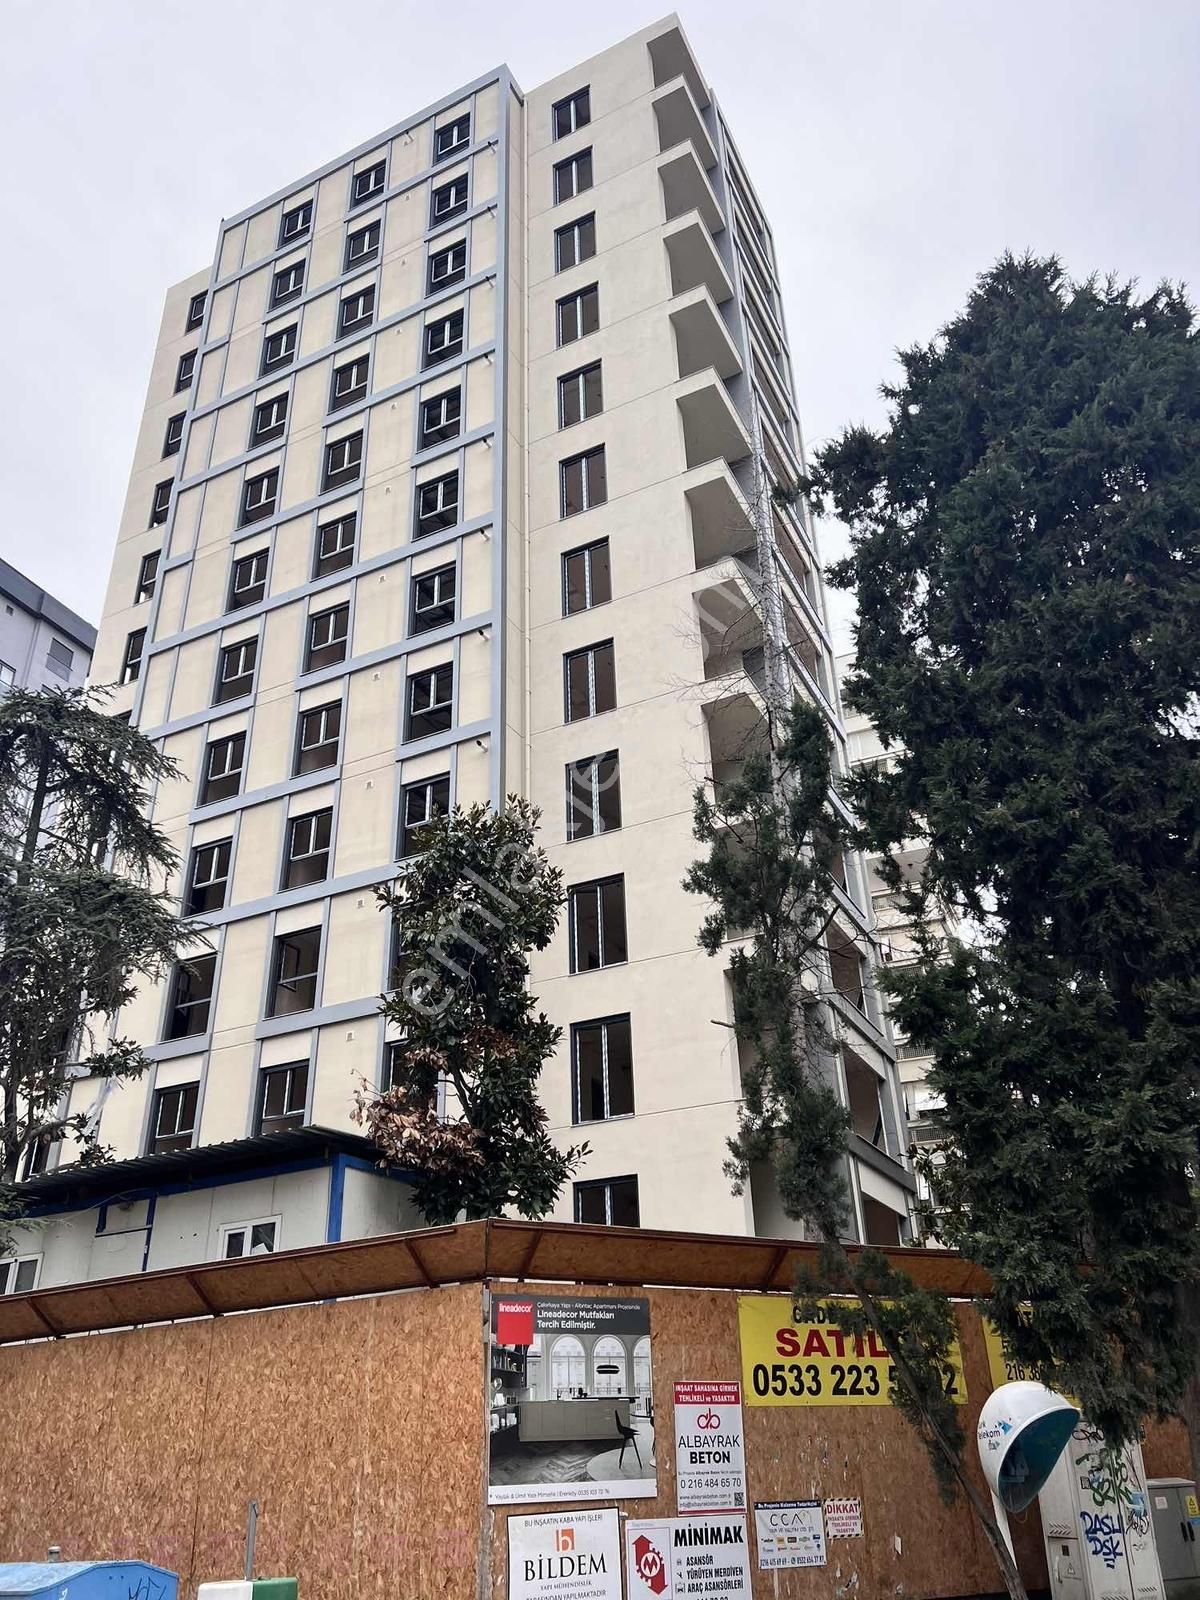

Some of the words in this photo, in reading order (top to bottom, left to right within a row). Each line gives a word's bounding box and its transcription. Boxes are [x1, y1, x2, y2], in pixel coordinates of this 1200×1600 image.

[498, 1303, 532, 1313] lineadecor
[537, 1310, 578, 1319] Lineadecor
[579, 1311, 615, 1320] Mutfakları
[537, 1320, 560, 1328] Tercih
[561, 1320, 596, 1331] Edilmiştir.
[775, 1328, 900, 1358] SATIL
[752, 1363, 822, 1397] 0533
[830, 1364, 880, 1397] 223
[678, 1394, 705, 1402] TEHLİKELİ
[678, 1434, 741, 1448] ALBAYRAK
[690, 1451, 731, 1465] BETON
[680, 1479, 686, 1489] 0
[687, 1478, 703, 1489] 216
[704, 1478, 719, 1488] 484
[720, 1478, 731, 1488] 65
[731, 1477, 742, 1487] 70
[826, 1502, 859, 1514] DİKKAT
[533, 1518, 559, 1527] İNŞAATIN
[560, 1516, 574, 1524] KABA
[587, 1514, 603, 1523] İŞLERİ
[769, 1513, 804, 1527] CCA
[674, 1522, 744, 1547] MİNİMAK
[686, 1553, 714, 1566] ASANSÖR
[524, 1552, 608, 1581] BİLDEM
[686, 1567, 713, 1580] YÜRÜYEN
[714, 1565, 744, 1578] MERDİVEN
[553, 1580, 593, 1590] MÜHENDİSLİK
[687, 1582, 704, 1594] ARAÇ
[704, 1579, 744, 1592] ASANSÖRLERİ
